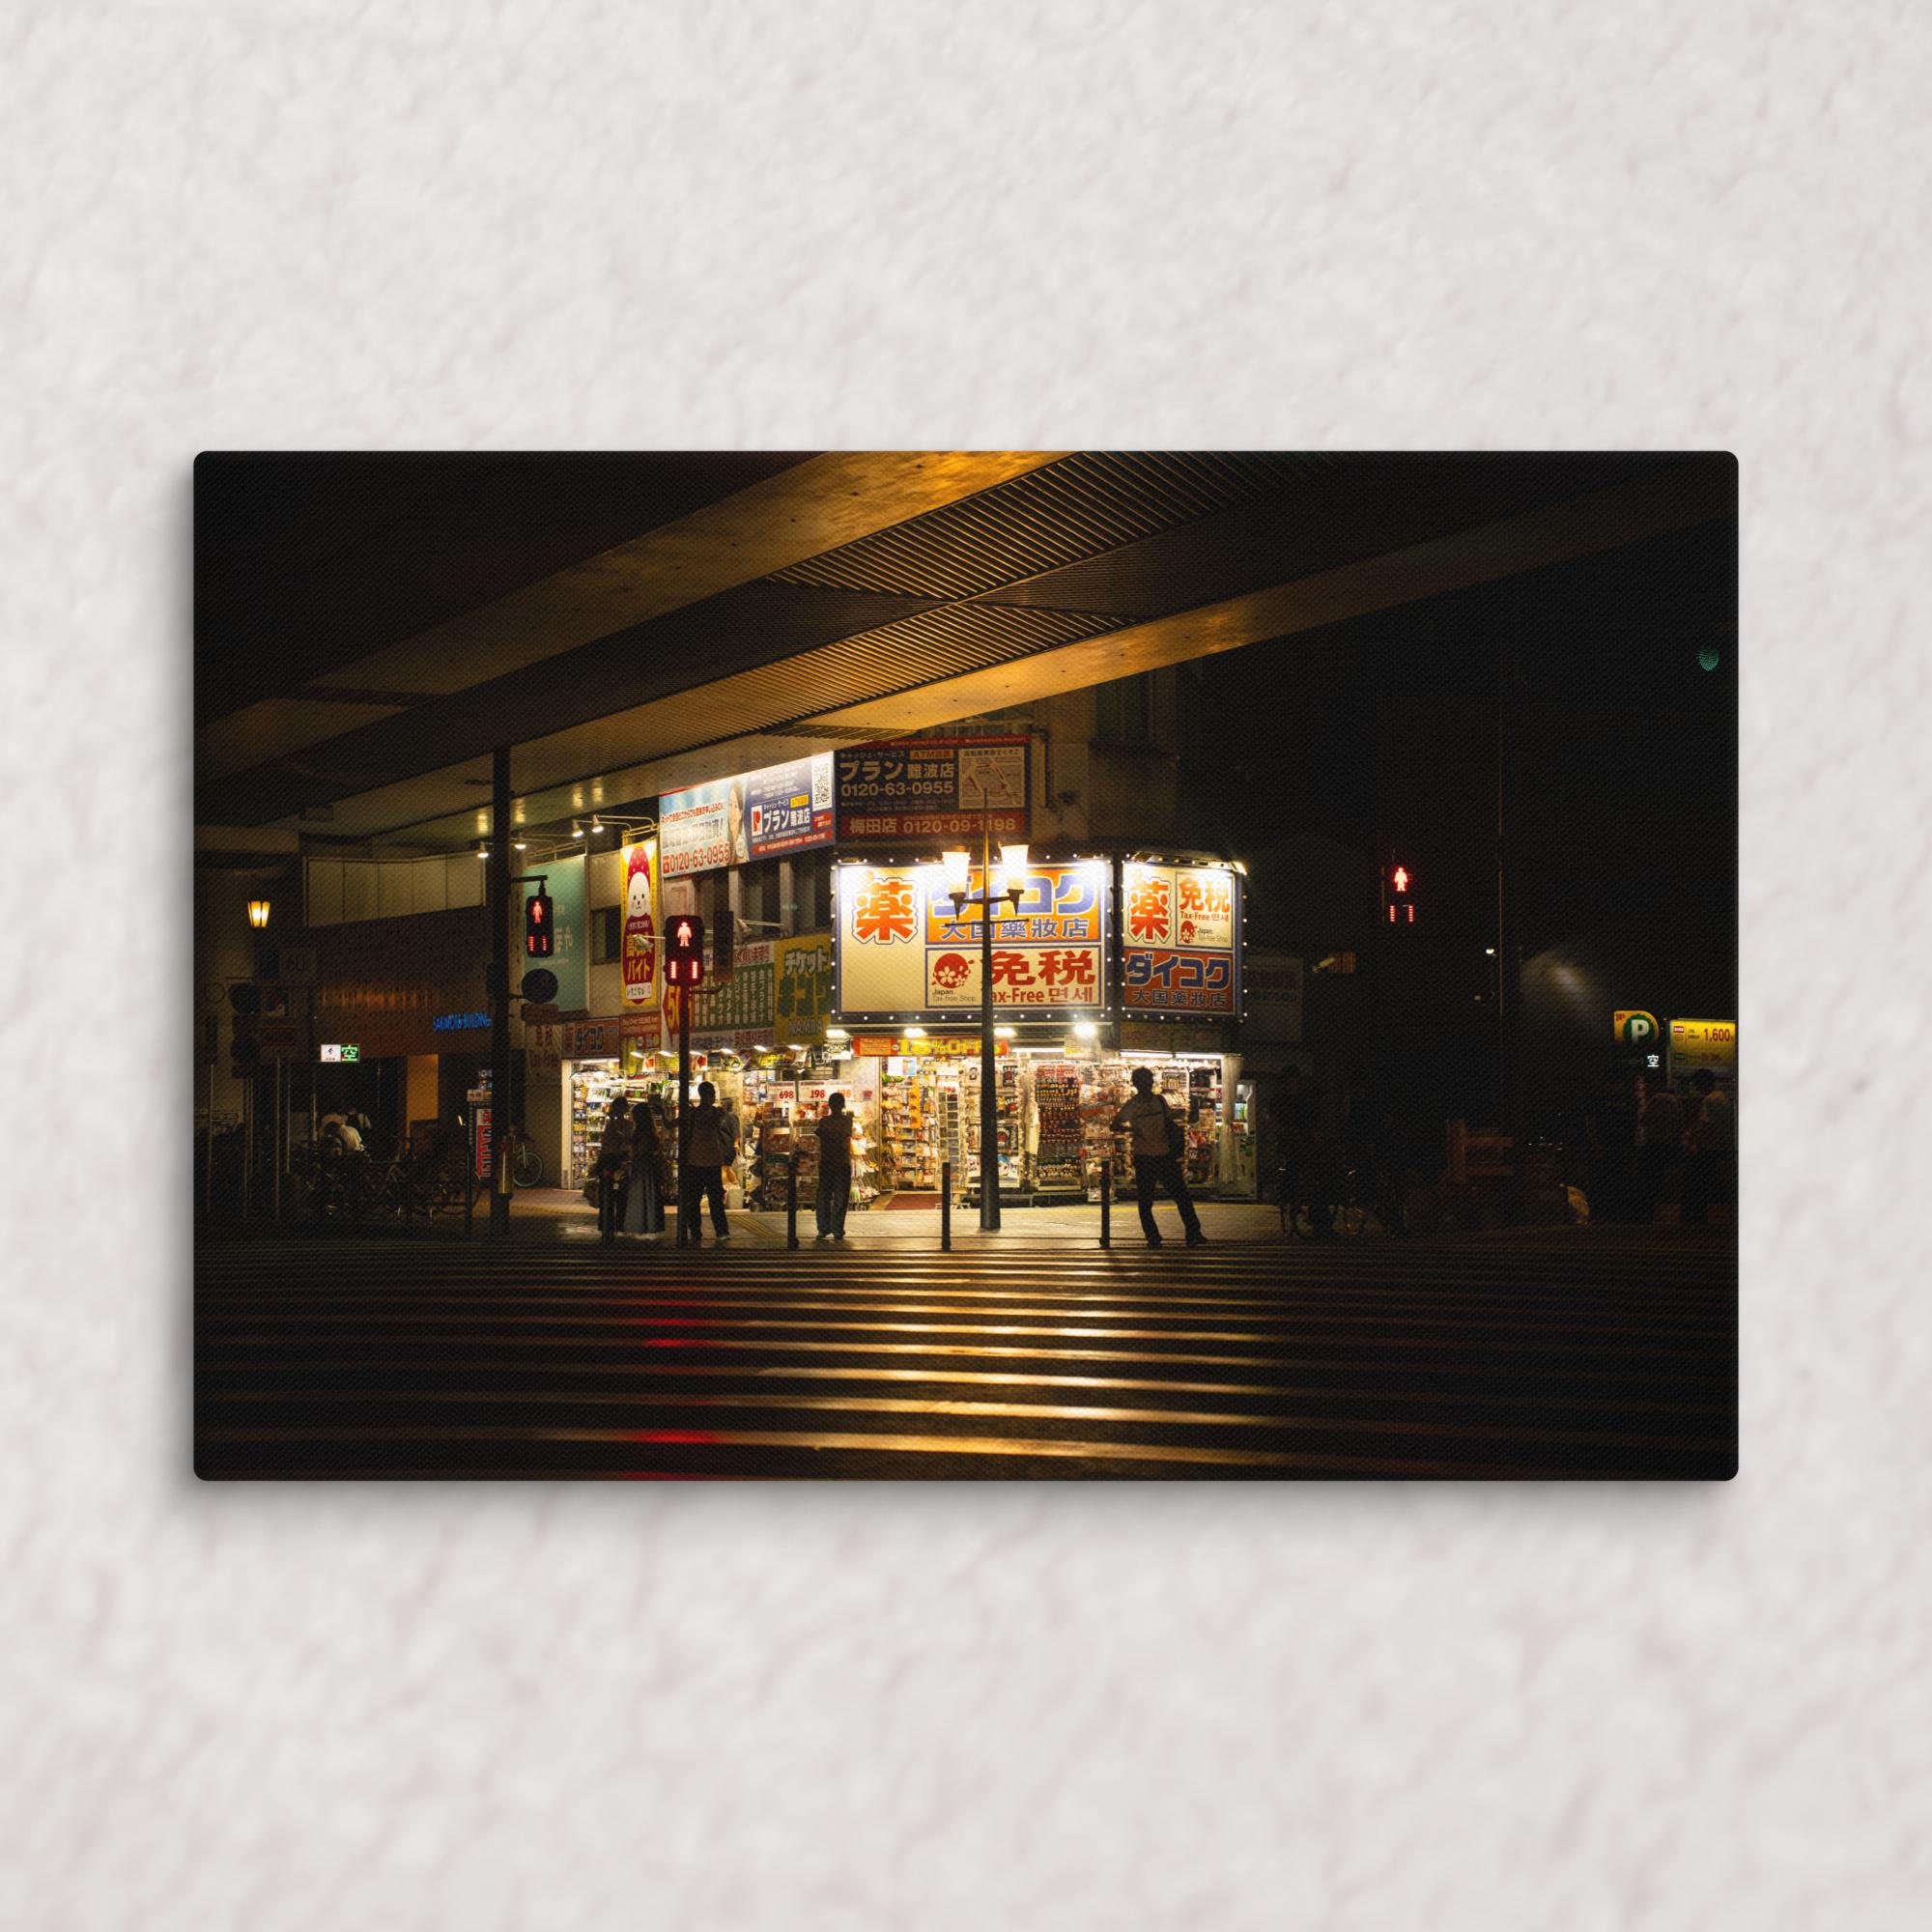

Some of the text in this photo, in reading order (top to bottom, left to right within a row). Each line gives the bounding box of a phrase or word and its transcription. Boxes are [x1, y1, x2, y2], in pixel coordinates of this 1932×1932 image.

[839, 760, 904, 781] プラン
[840, 781, 954, 797] 0120-63-0955
[764, 810, 790, 833] プラン
[849, 818, 897, 834] 梅田店
[854, 877, 916, 941] 薬
[1129, 880, 1170, 940] 薬
[1179, 910, 1209, 921] Tax-Free
[990, 950, 1096, 986] 免税
[1125, 952, 1231, 990] ダイコク
[983, 987, 1043, 1004] ax-Free
[1704, 1028, 1730, 1042] 1,600
[1646, 1054, 1660, 1067] 空
